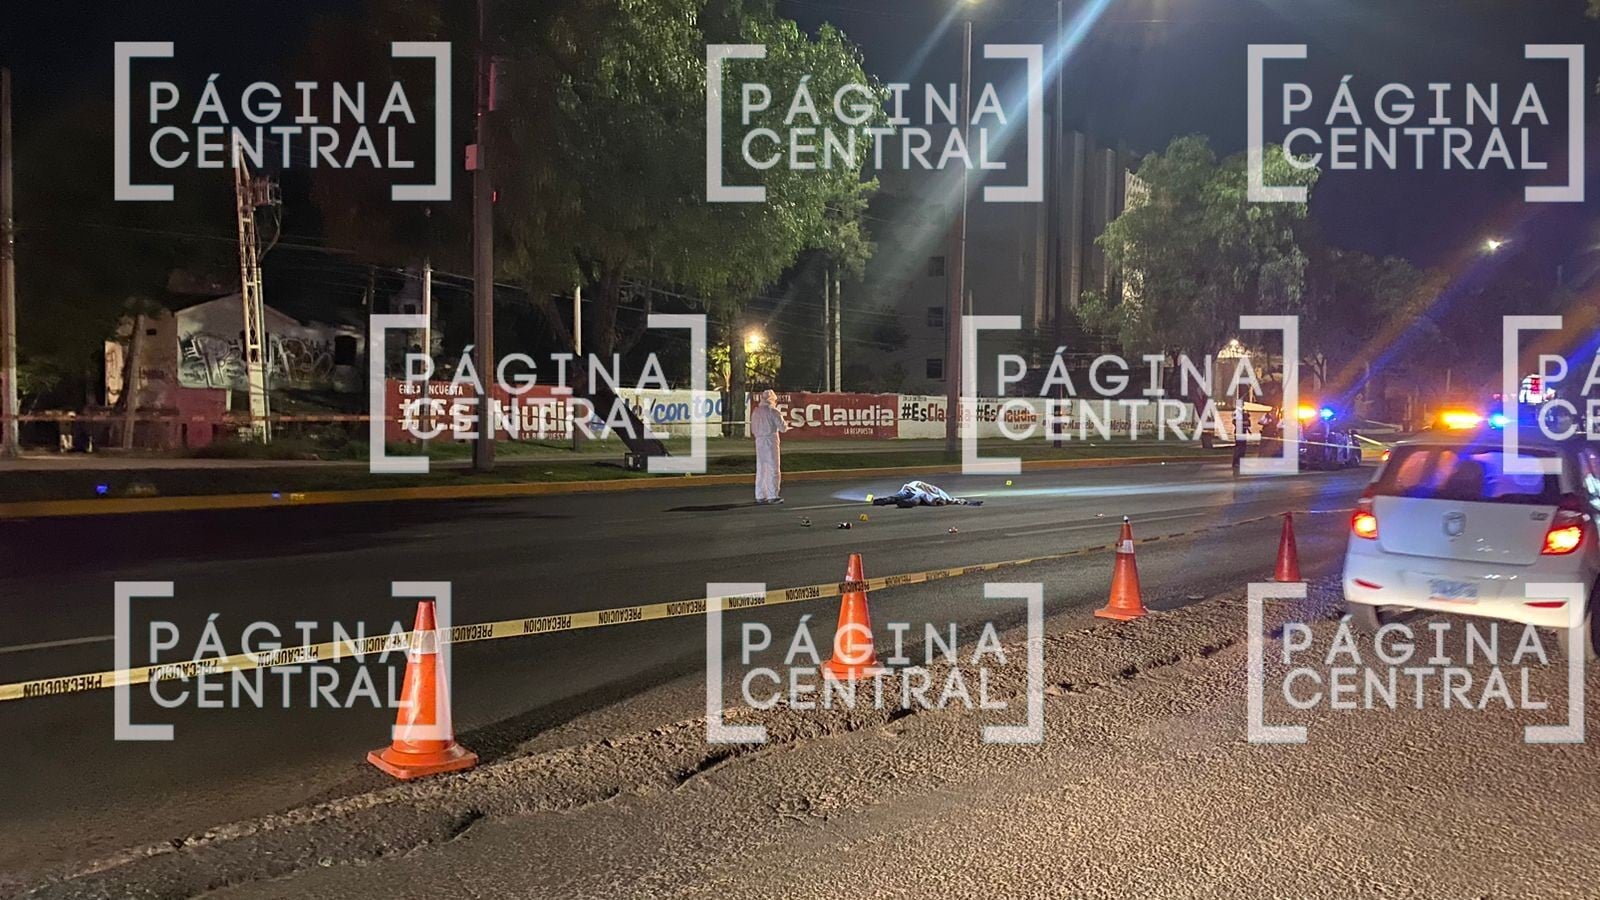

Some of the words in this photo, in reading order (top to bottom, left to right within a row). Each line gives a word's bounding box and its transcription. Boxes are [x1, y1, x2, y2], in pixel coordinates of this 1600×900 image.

[429, 385, 463, 396] NCUESTA
[728, 592, 765, 608] PRECAUCION
[785, 586, 819, 601] PRECAUCION
[598, 607, 642, 625] PRECAUCION
[666, 599, 706, 616] PRECAUCION
[522, 615, 572, 634] PRECAUCION
[353, 634, 409, 656] PRECAUCION
[256, 645, 319, 669] PRECAUCION
[147, 659, 219, 683] PRECAUCION
[23, 674, 103, 699] PRECAUCION
